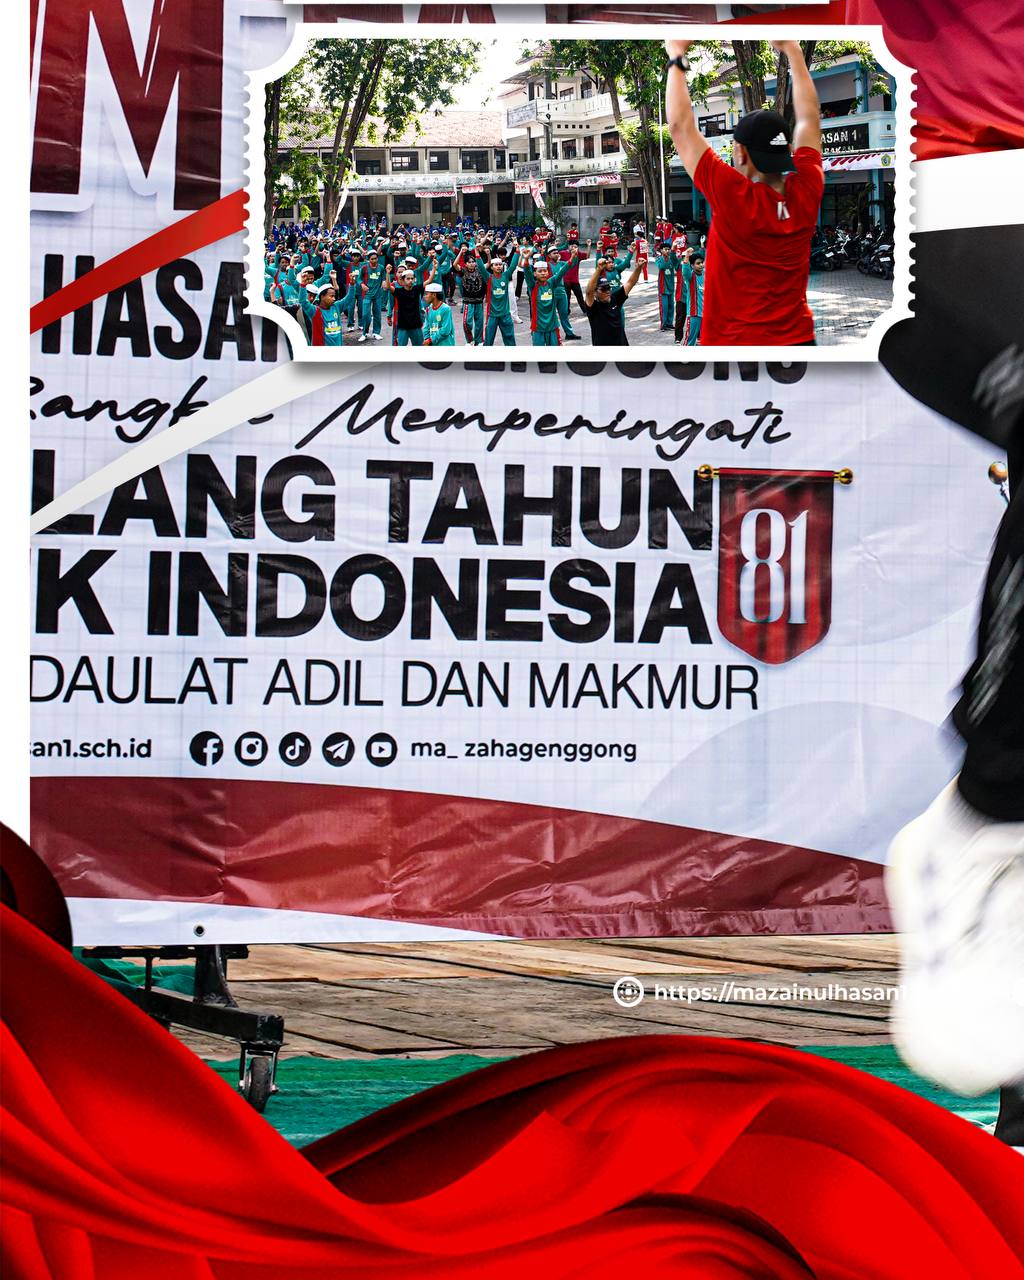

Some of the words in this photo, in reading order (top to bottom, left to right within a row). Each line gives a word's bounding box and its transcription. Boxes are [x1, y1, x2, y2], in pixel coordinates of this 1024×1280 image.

[295, 383, 791, 462] Memperingati
[366, 459, 713, 551] TAHUN
[147, 550, 713, 645] INDONESIA
[739, 508, 810, 625] 81
[263, 658, 383, 706] ADIL
[401, 660, 510, 708] DAN
[528, 664, 758, 710] MAKMUR
[465, 739, 637, 762] zahagenggong
